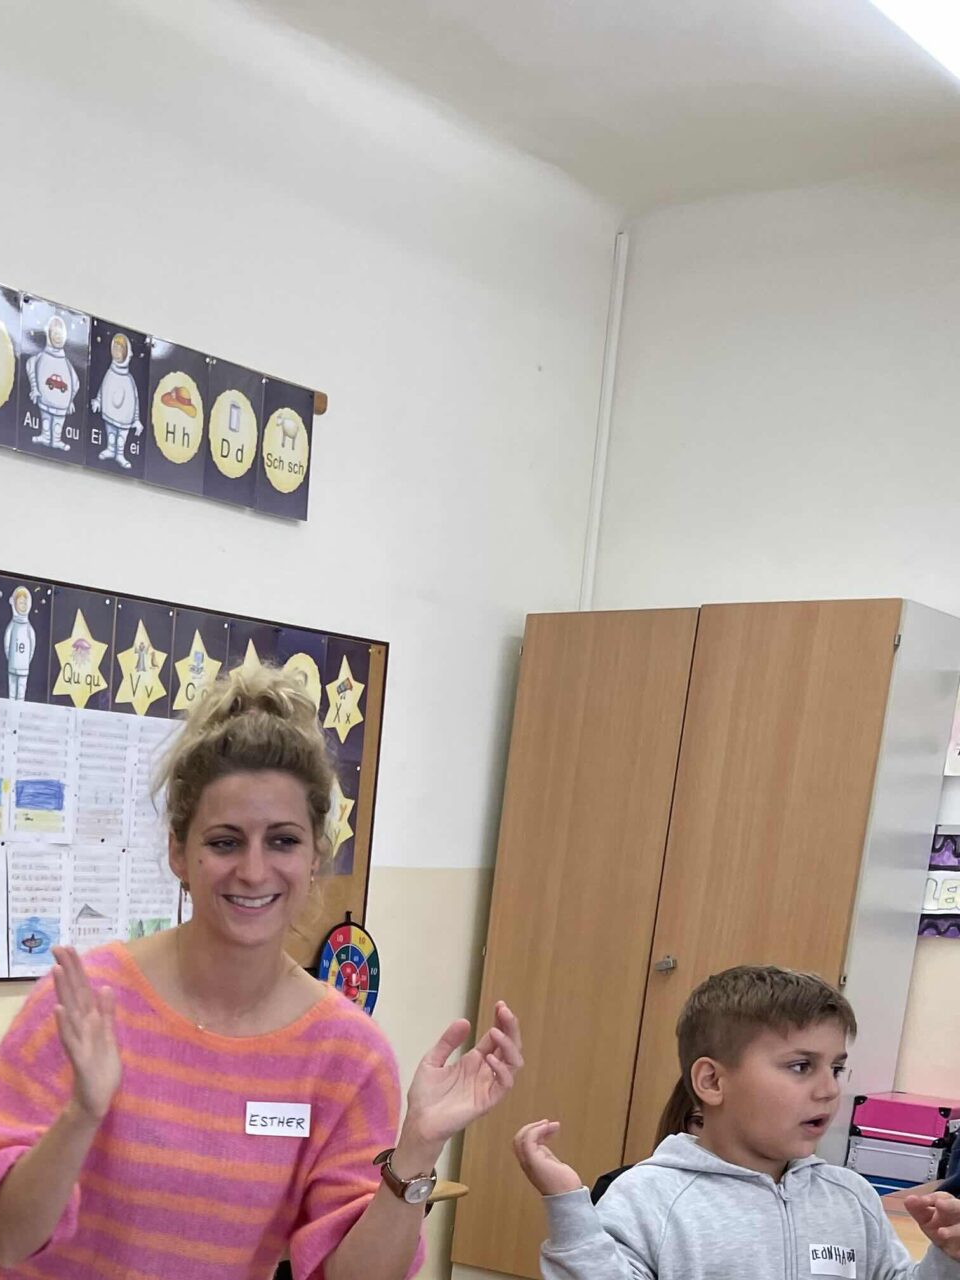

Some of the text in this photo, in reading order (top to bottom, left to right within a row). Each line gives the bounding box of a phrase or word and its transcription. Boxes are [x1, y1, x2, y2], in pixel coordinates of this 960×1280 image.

[24, 411, 39, 430] Au
[266, 453, 305, 476] Sch sch
[62, 663, 80, 687] Qu
[248, 1113, 305, 1130] ESTHER
